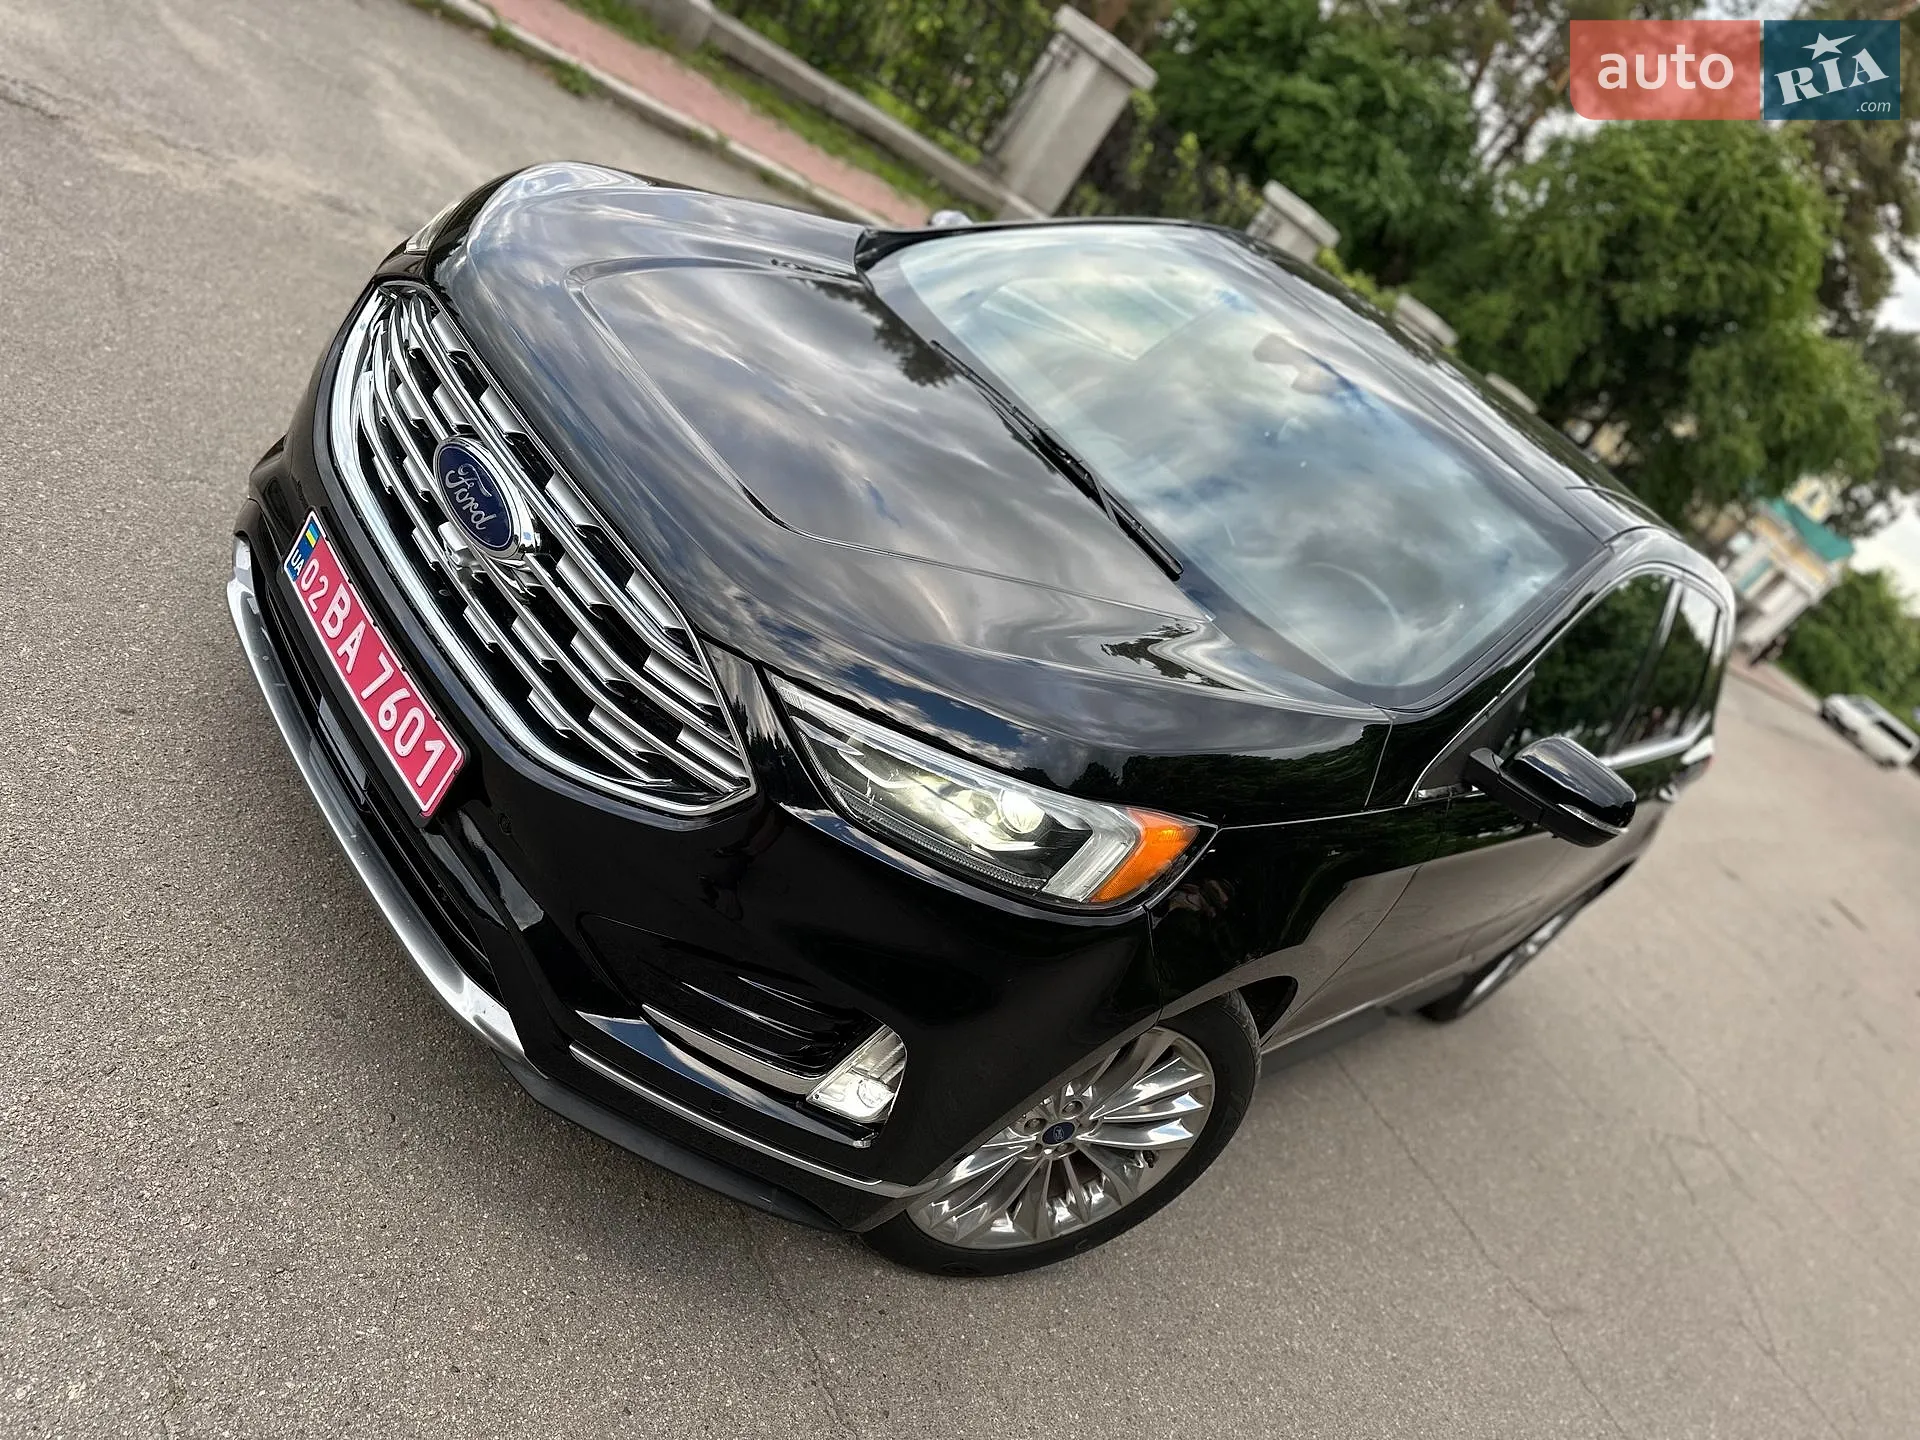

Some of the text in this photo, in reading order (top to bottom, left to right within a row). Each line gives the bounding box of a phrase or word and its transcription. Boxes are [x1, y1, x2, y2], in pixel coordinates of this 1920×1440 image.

[445, 463, 493, 530] Ford
[291, 549, 305, 576] UA
[361, 652, 446, 787] 7601
